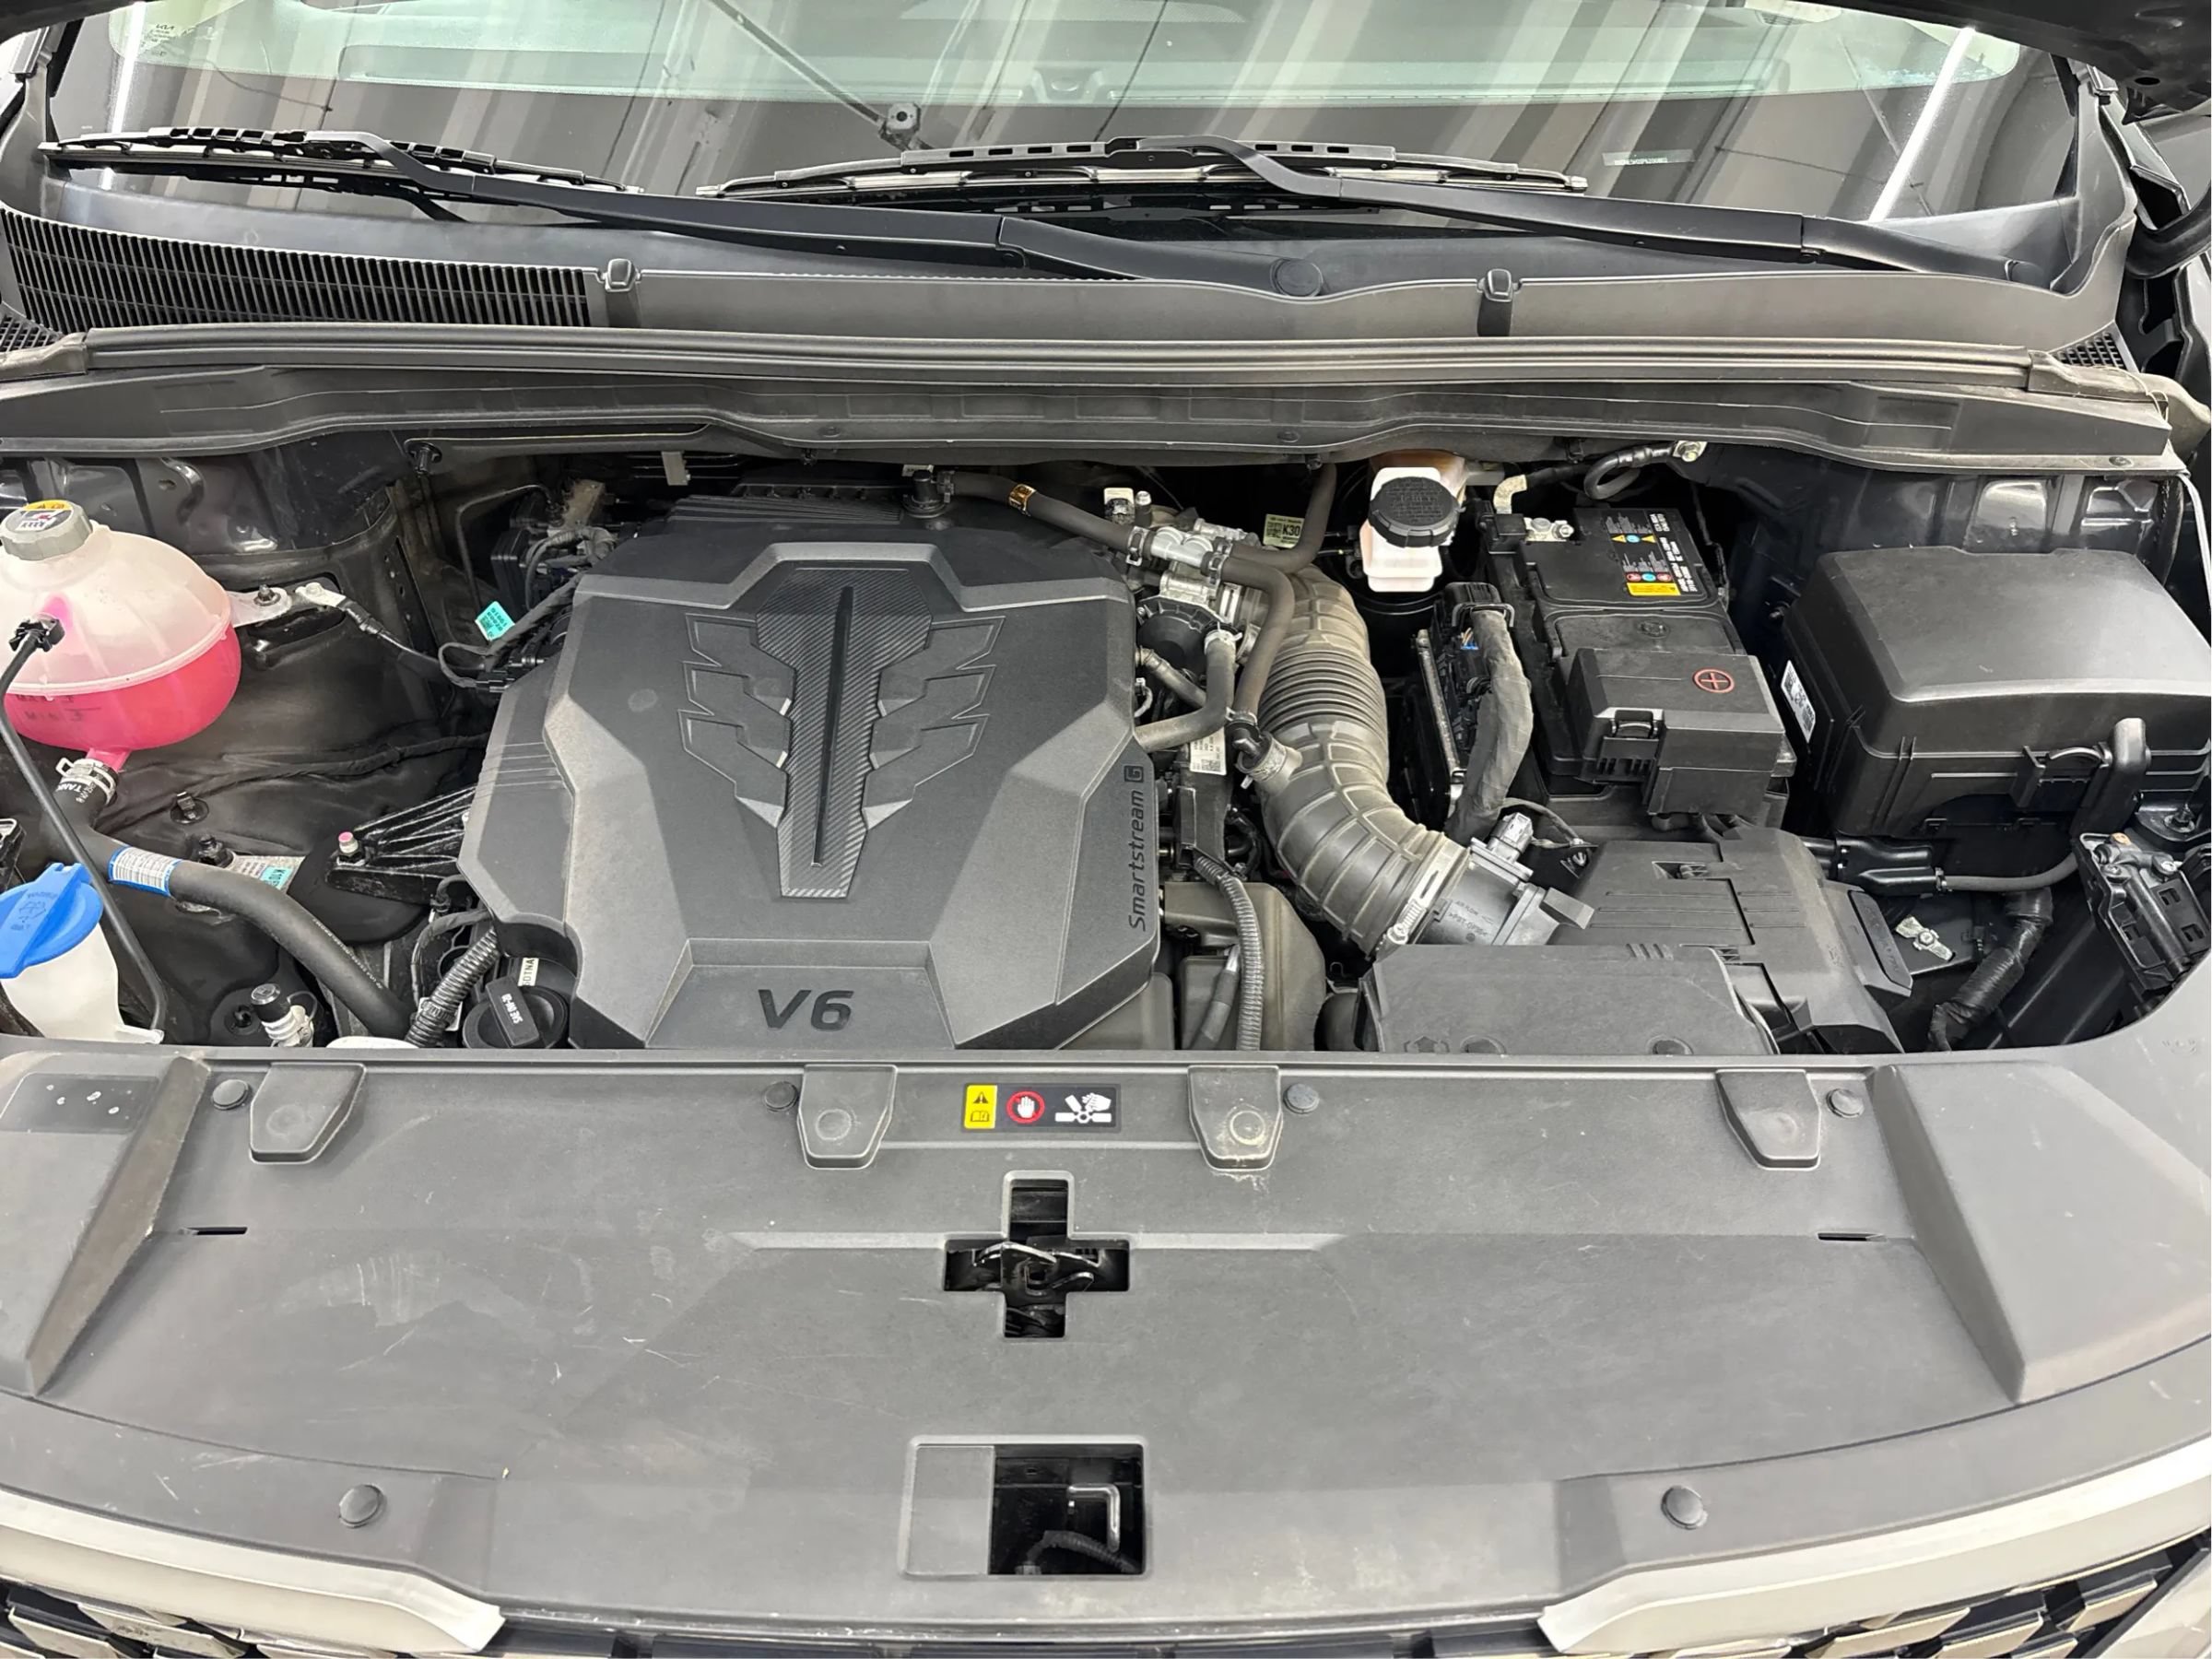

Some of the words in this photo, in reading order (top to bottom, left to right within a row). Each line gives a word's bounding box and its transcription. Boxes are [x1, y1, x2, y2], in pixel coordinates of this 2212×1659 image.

[1282, 524, 1300, 536] K30
[1128, 790, 1146, 932] Smartstream
[758, 989, 854, 1031] V6
